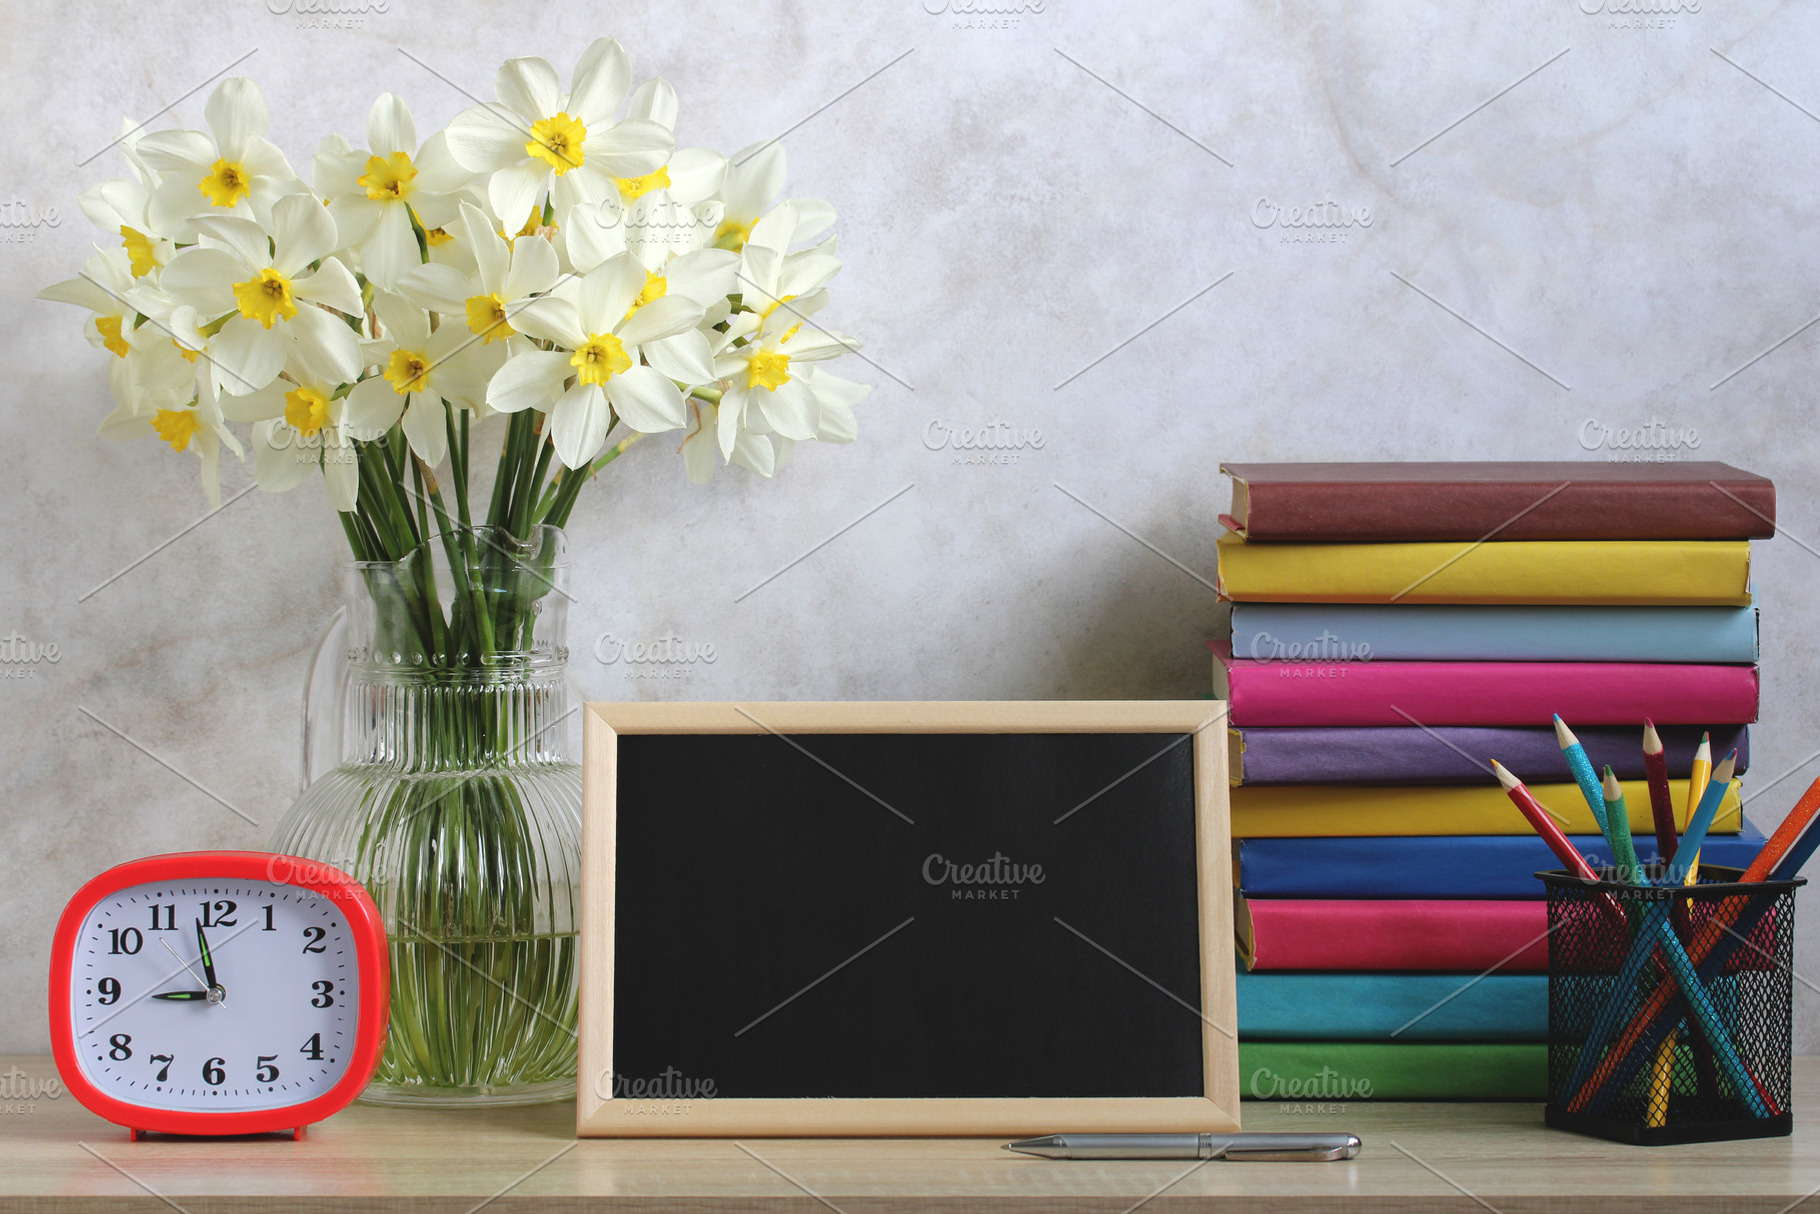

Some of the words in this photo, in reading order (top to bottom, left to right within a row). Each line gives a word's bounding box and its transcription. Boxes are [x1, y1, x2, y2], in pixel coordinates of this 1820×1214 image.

[148, 903, 179, 931] 11
[199, 900, 238, 927] 12
[261, 904, 277, 931] 1
[107, 927, 144, 955] 10
[302, 927, 327, 954] 2
[97, 977, 122, 1005] 9
[310, 980, 335, 1008] 3
[109, 1033, 133, 1061] 8
[299, 1032, 325, 1060] 4
[149, 1054, 175, 1082] 7
[202, 1057, 226, 1085] 6
[256, 1054, 280, 1082] 5
